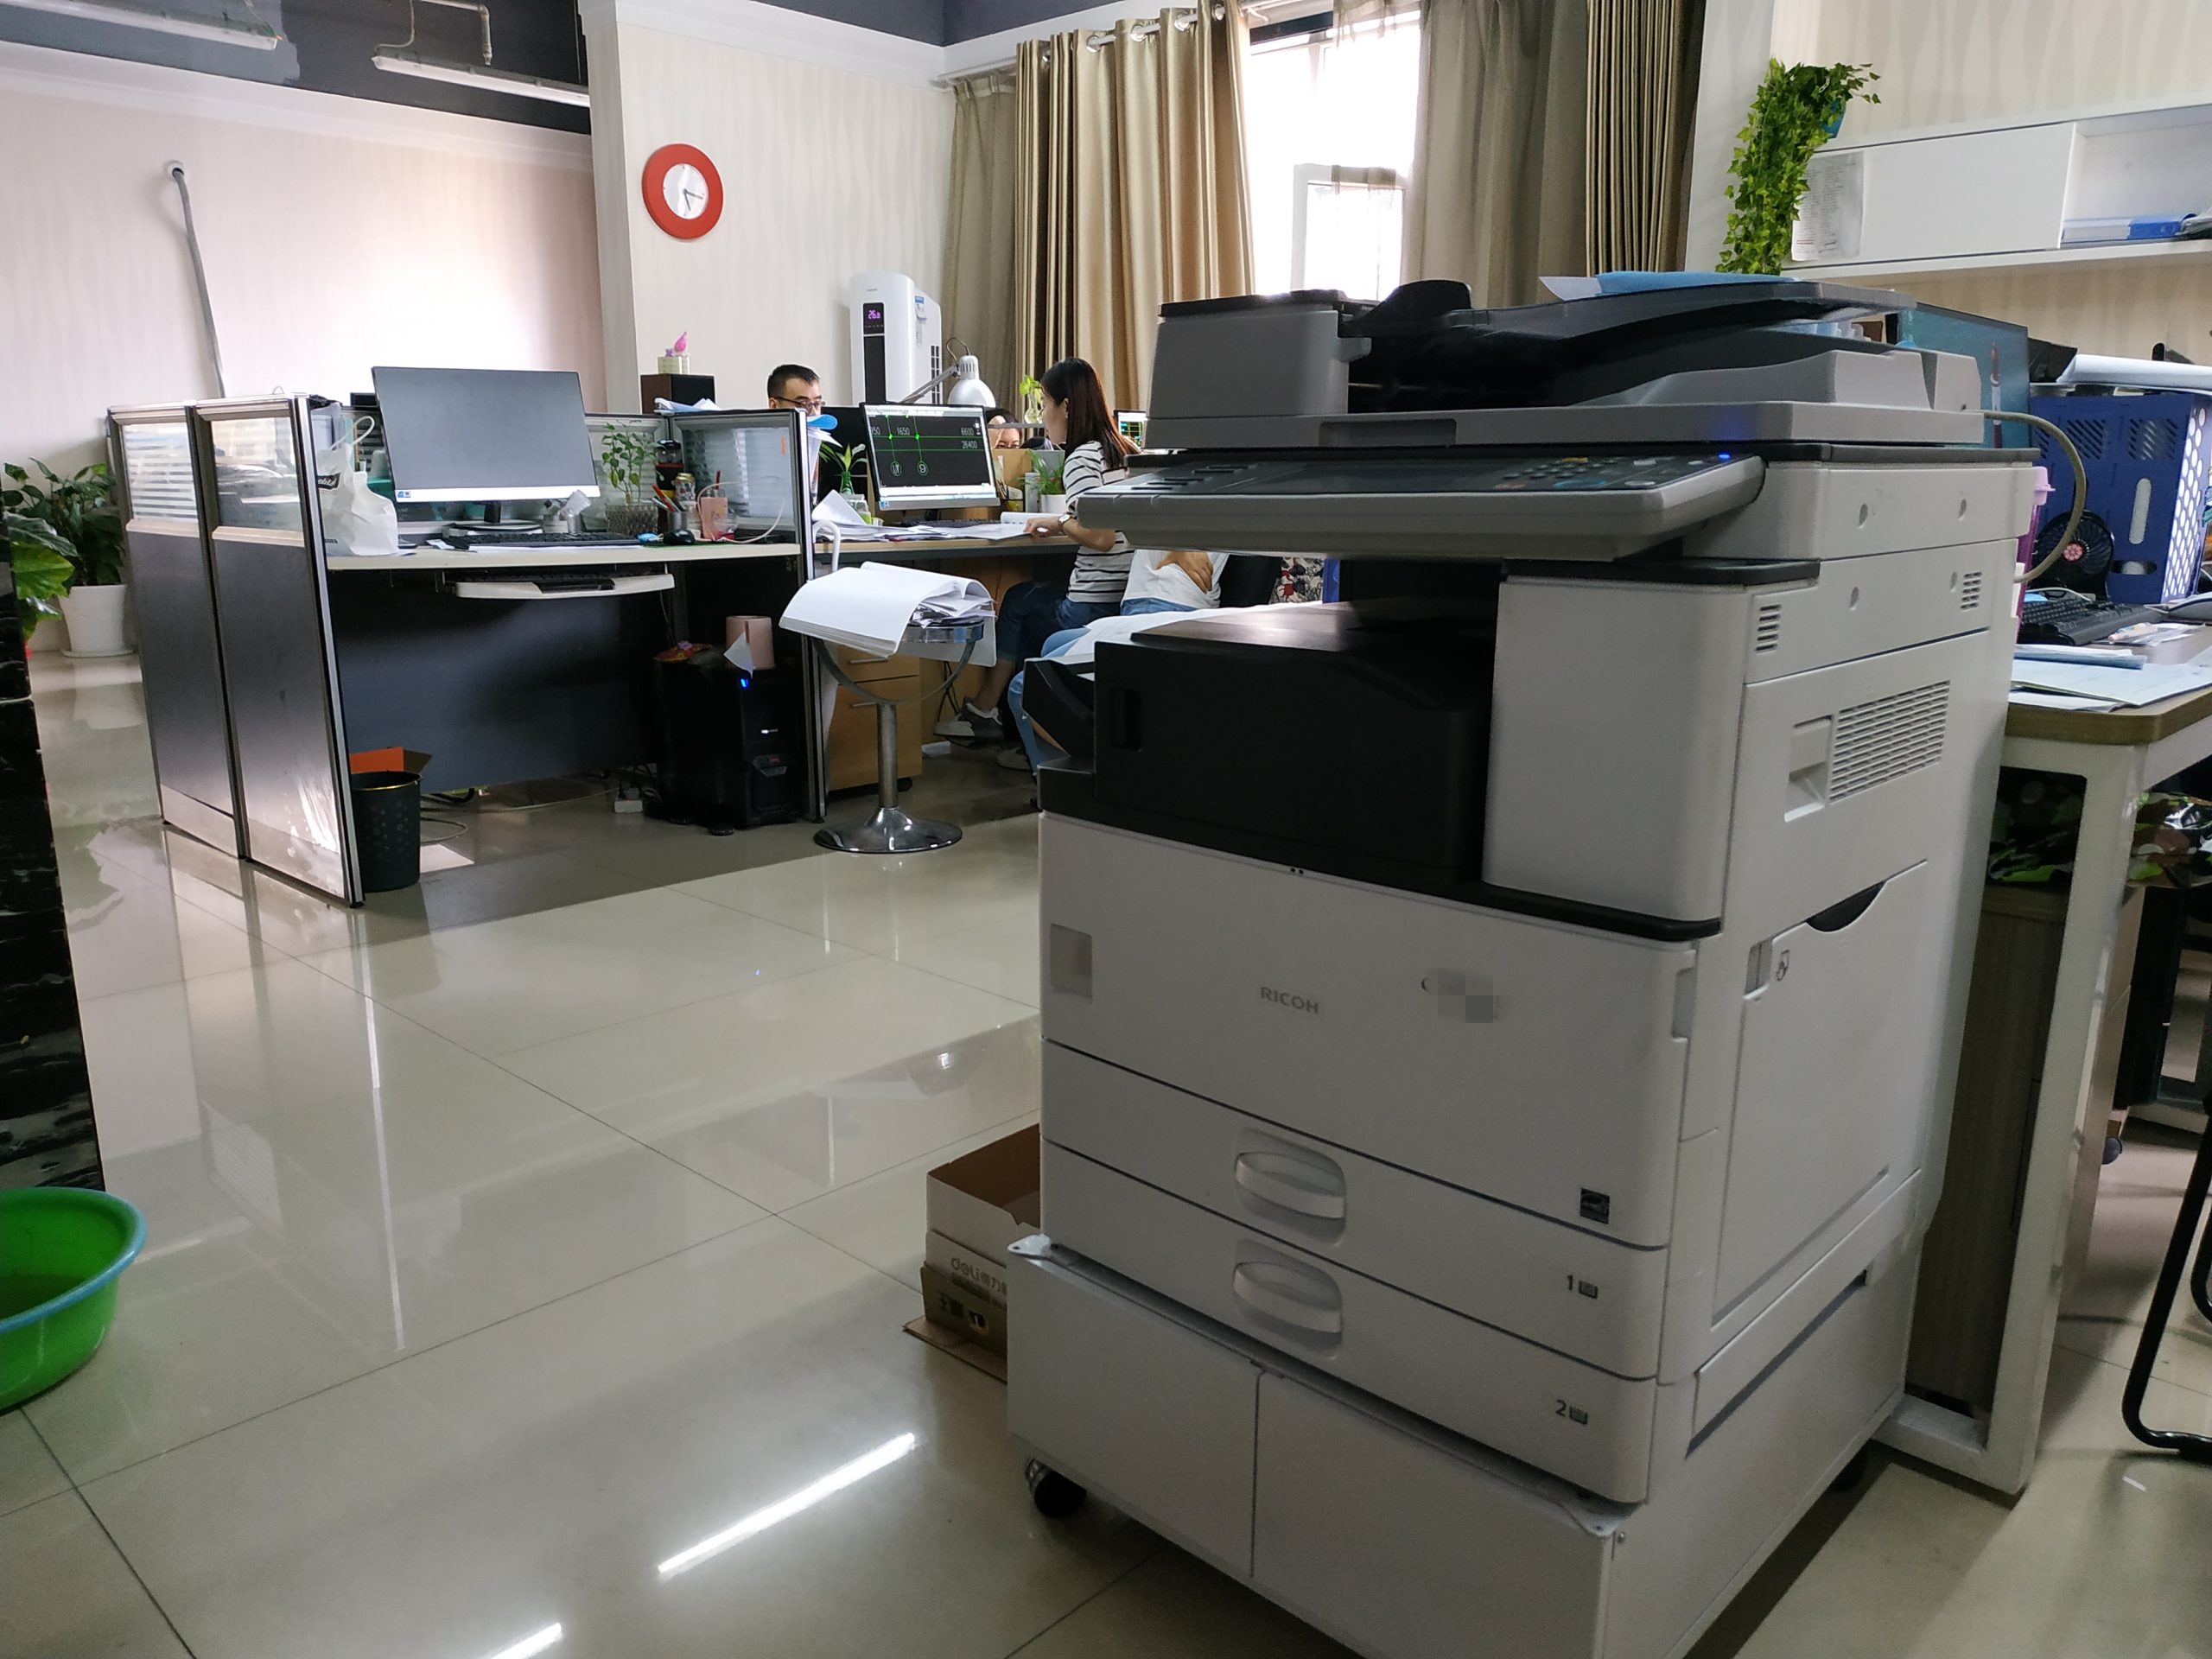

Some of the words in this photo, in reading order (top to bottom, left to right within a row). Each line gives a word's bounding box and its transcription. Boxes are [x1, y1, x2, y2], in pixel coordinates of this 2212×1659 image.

[897, 427, 910, 435] 1650
[918, 464, 926, 474] 9
[1261, 986, 1319, 1014] RICOH
[1567, 1274, 1573, 1292] 1
[1555, 1399, 1567, 1417] 2
